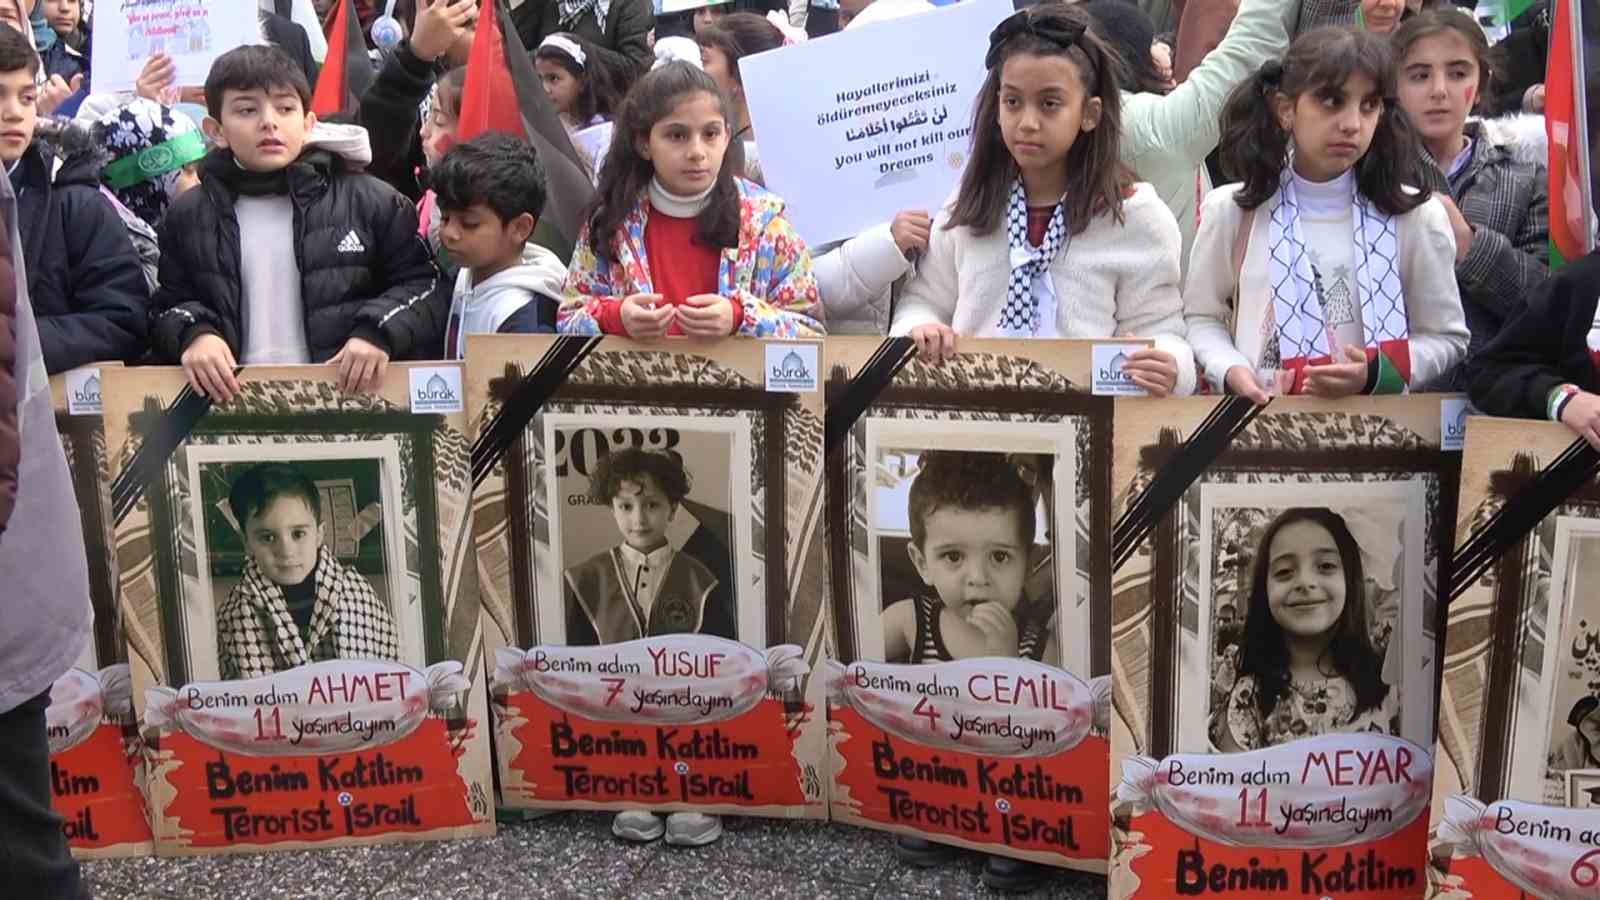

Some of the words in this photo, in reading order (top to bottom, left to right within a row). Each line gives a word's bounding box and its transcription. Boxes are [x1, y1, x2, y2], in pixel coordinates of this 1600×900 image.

[817, 82, 957, 126] öldüremeyeceksiniz
[836, 70, 930, 103] Hayallerimizi
[866, 144, 890, 159] will
[895, 138, 917, 152] not
[921, 131, 943, 147] kill
[947, 127, 970, 140] our
[879, 152, 934, 174] Dreams
[772, 365, 810, 378] burak
[1100, 367, 1132, 380] bura
[417, 388, 456, 400] burak
[534, 650, 592, 673] Benim
[598, 653, 640, 674] adım
[647, 647, 726, 678] YUSUF
[187, 687, 248, 710] Benim
[254, 685, 298, 707] adım
[308, 672, 411, 704] AHMET
[600, 678, 625, 706] 7
[630, 685, 734, 716] yaşındayım
[855, 666, 911, 693] Benim
[916, 674, 959, 698] adım
[967, 673, 1068, 712] CEMİL
[253, 707, 288, 741] 11
[290, 712, 396, 745] yaşındayım
[551, 713, 647, 758] Benim
[656, 726, 759, 761] Katilim
[912, 697, 941, 731] 4
[950, 714, 1056, 749] yaşındayım
[205, 752, 308, 800] Benim
[316, 752, 424, 792] Katilim
[554, 765, 669, 799] Terorist
[872, 733, 968, 788] Benim
[976, 758, 1083, 804] Katilim
[1168, 760, 1235, 786] Benim
[1241, 759, 1290, 785] adım
[1301, 747, 1412, 786] MEYAR
[210, 802, 333, 841] Terorist
[877, 786, 990, 833] Terorist
[1235, 787, 1273, 828] 11
[1274, 797, 1393, 835] yaşındayım
[1494, 806, 1571, 843] Benim
[1175, 838, 1288, 896] Benim
[1301, 850, 1416, 895] Katilim
[1570, 847, 1600, 888] 6
